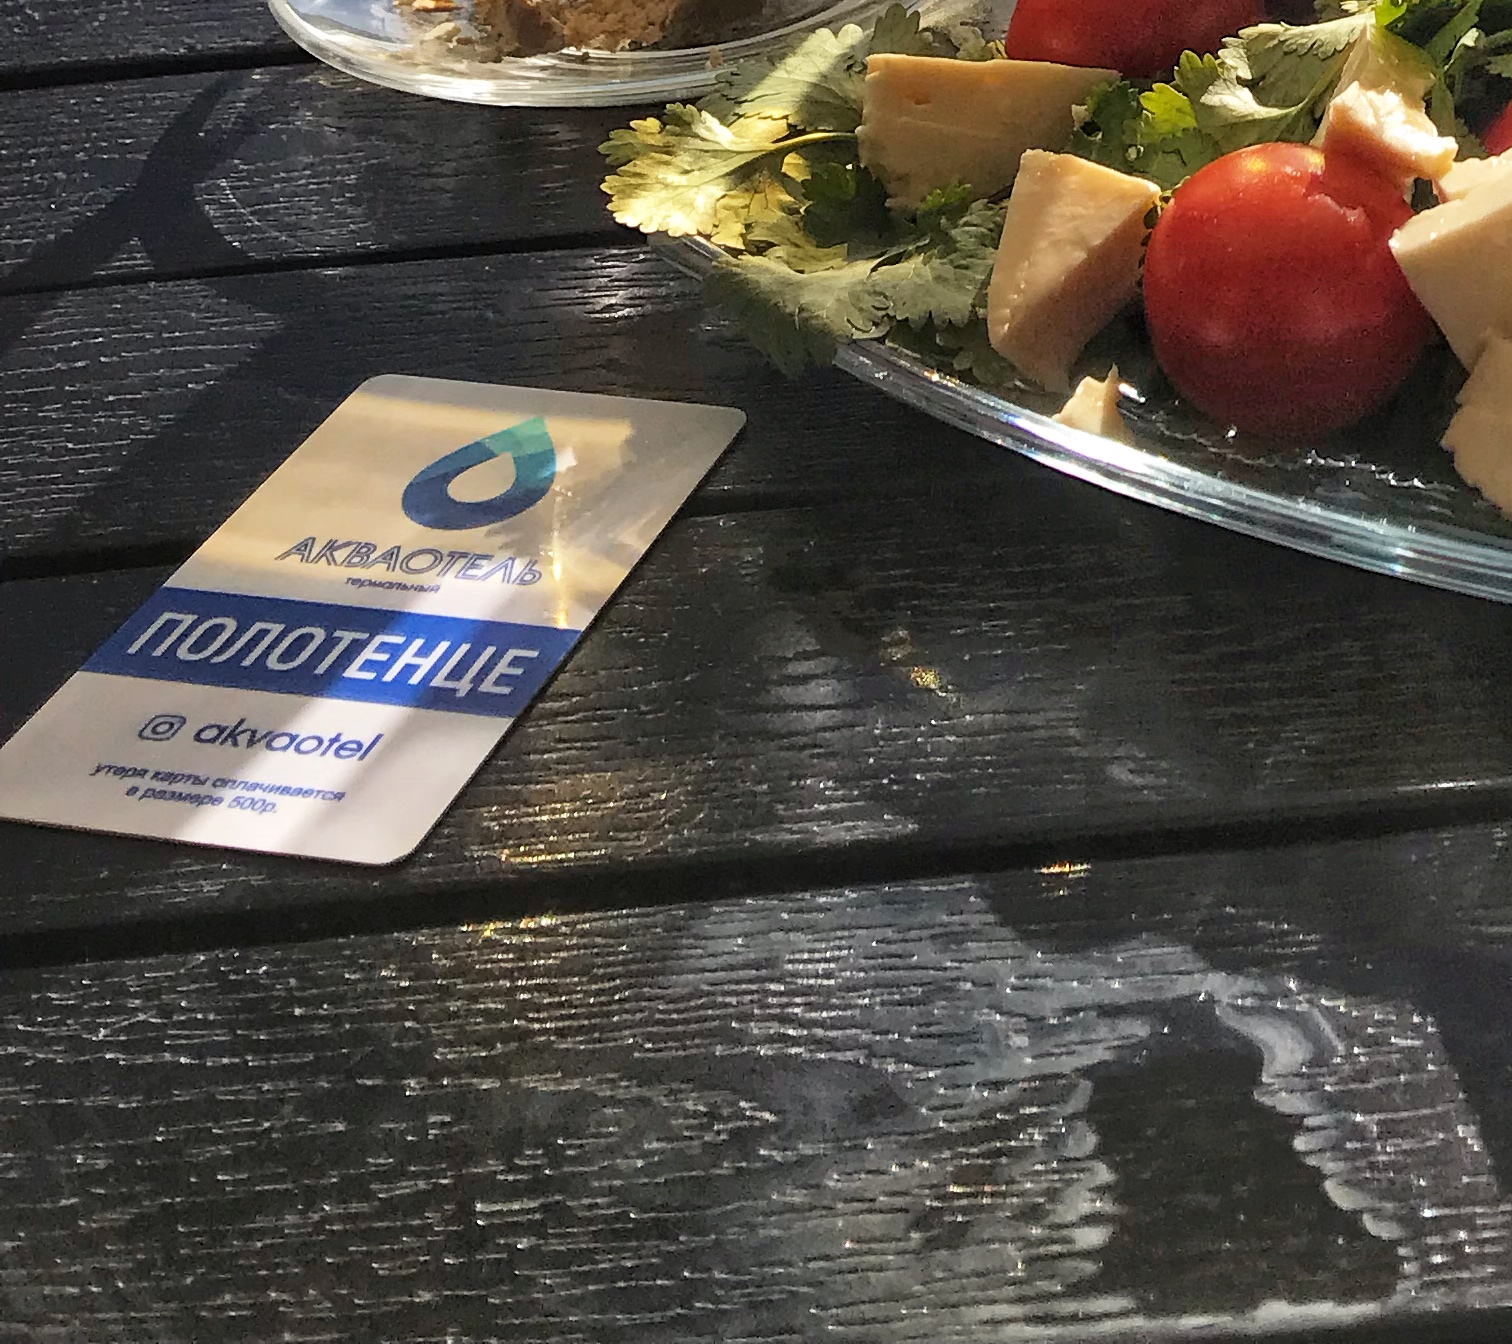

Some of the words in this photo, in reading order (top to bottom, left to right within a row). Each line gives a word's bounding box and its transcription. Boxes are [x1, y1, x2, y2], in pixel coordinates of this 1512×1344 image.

[274, 535, 543, 586] АКВАОТЕЛЬ
[345, 577, 440, 593] термальный
[126, 612, 540, 698] ПОЛОТЕНЦЕ
[193, 718, 384, 763] akvaotel
[88, 762, 149, 780] утеря
[150, 771, 210, 786] карты
[211, 777, 346, 802] оплачивается
[138, 787, 225, 807] размере
[227, 795, 278, 815] 500р.
